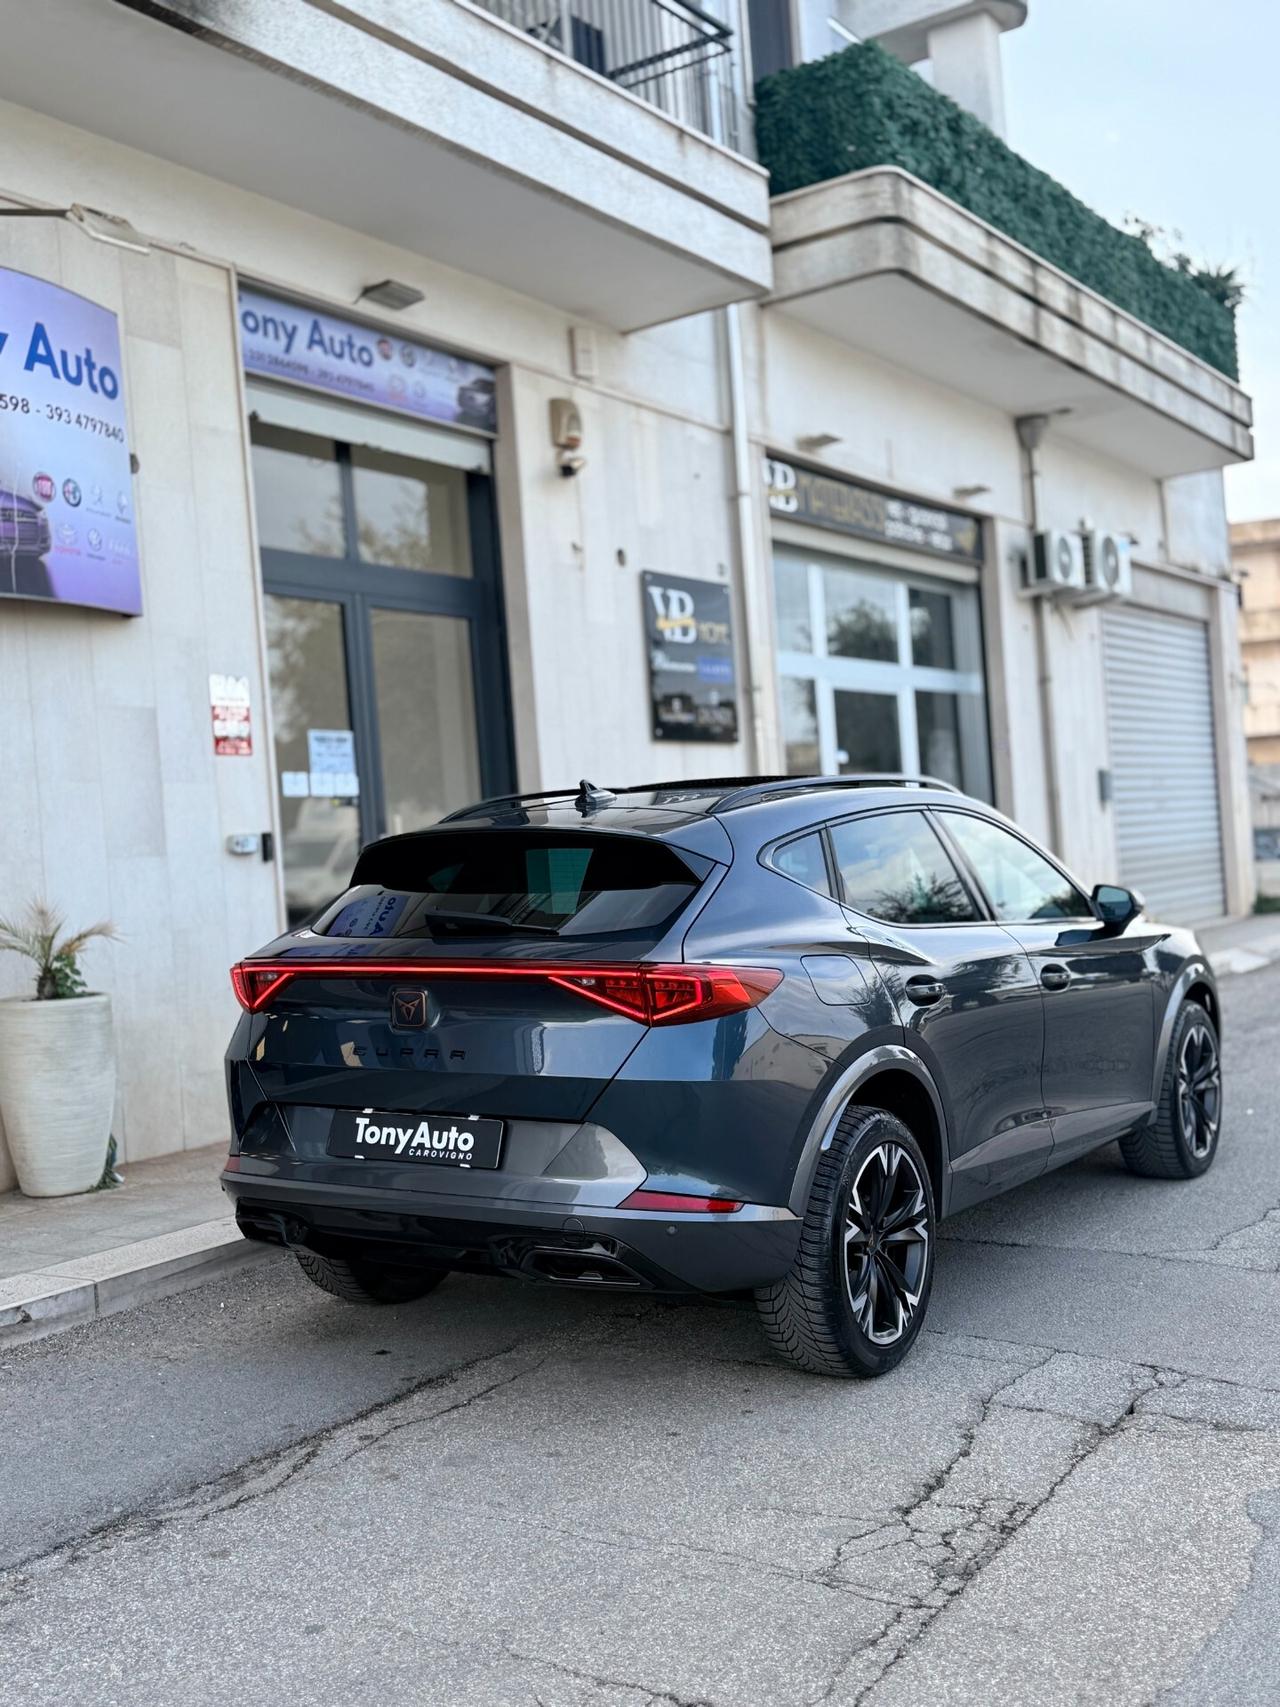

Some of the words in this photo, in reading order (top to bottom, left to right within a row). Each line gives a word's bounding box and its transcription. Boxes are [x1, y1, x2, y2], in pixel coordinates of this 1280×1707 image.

[239, 296, 298, 354] ony
[307, 319, 373, 367] Auto
[24, 321, 118, 400] Auto
[46, 404, 72, 424] 393
[353, 1047, 466, 1060] CUPRA
[408, 1148, 473, 1161] CAROVIGNO
